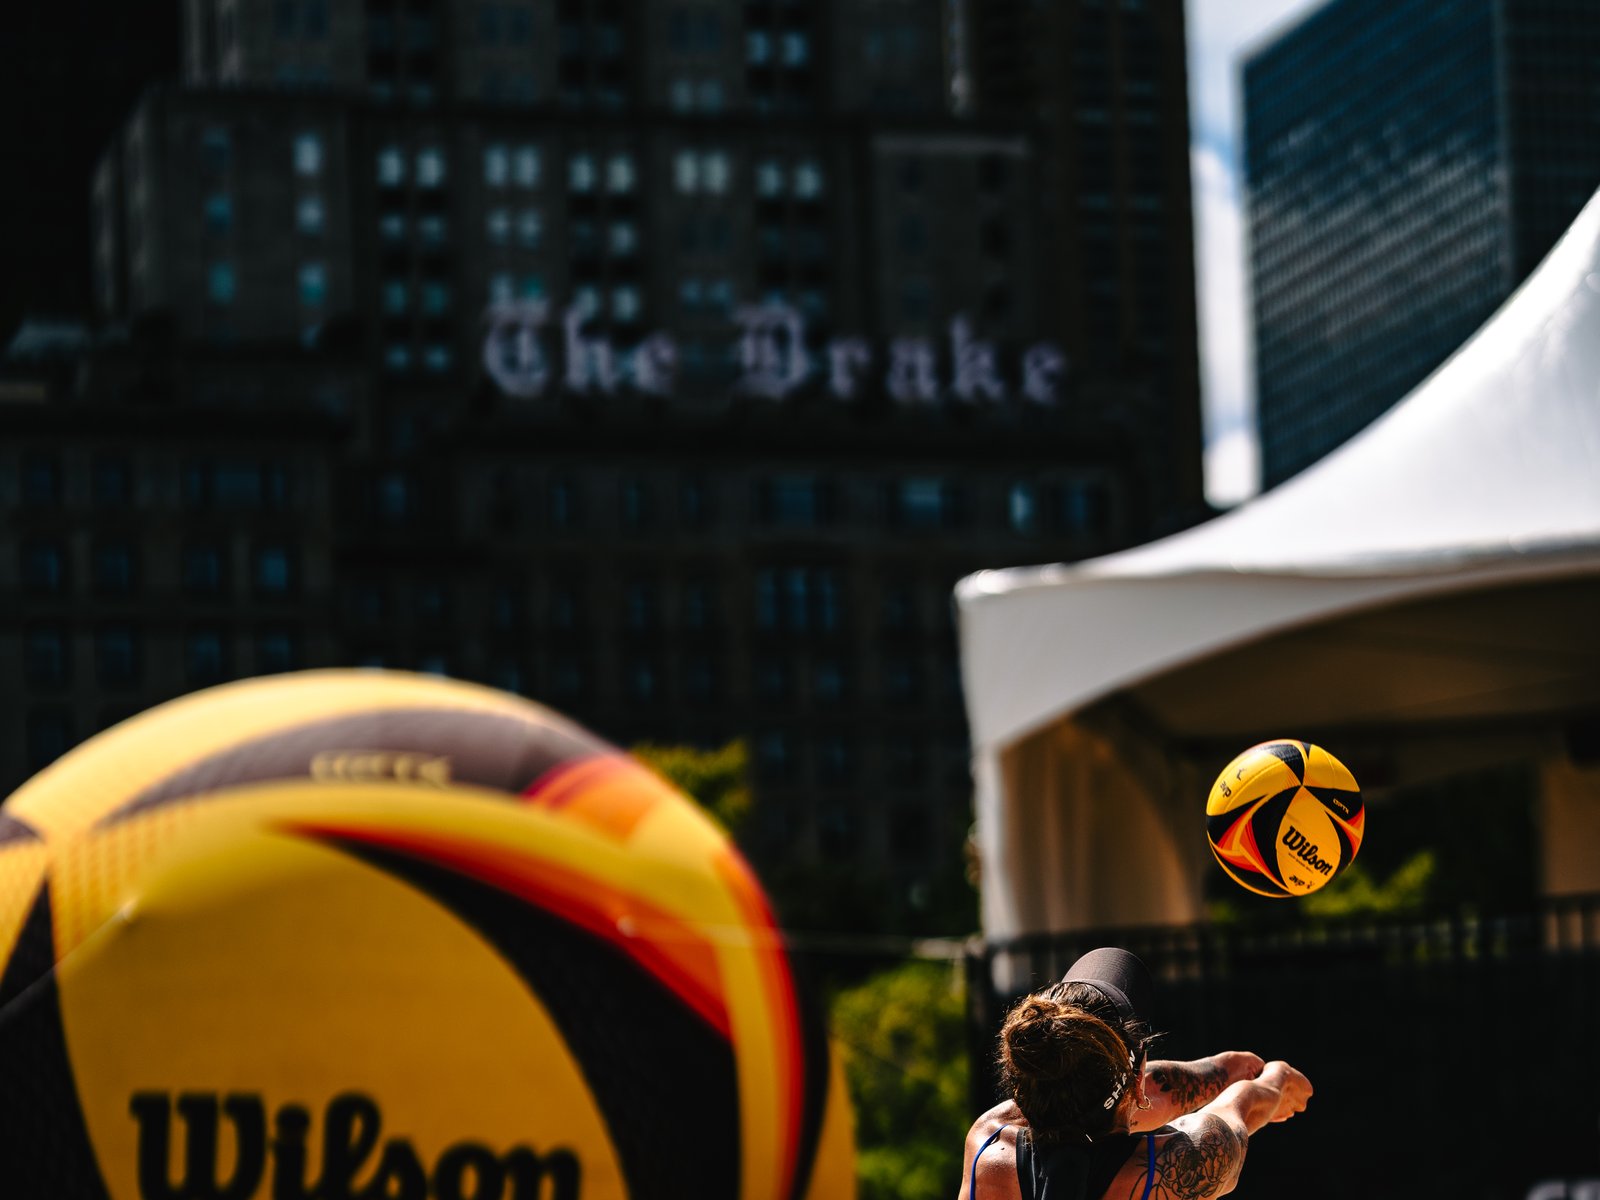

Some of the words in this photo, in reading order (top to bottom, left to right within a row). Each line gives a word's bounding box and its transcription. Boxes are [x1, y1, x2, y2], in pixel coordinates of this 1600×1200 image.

[484, 294, 674, 396] The
[732, 303, 1066, 402] Drake
[1282, 825, 1333, 876] Wilson
